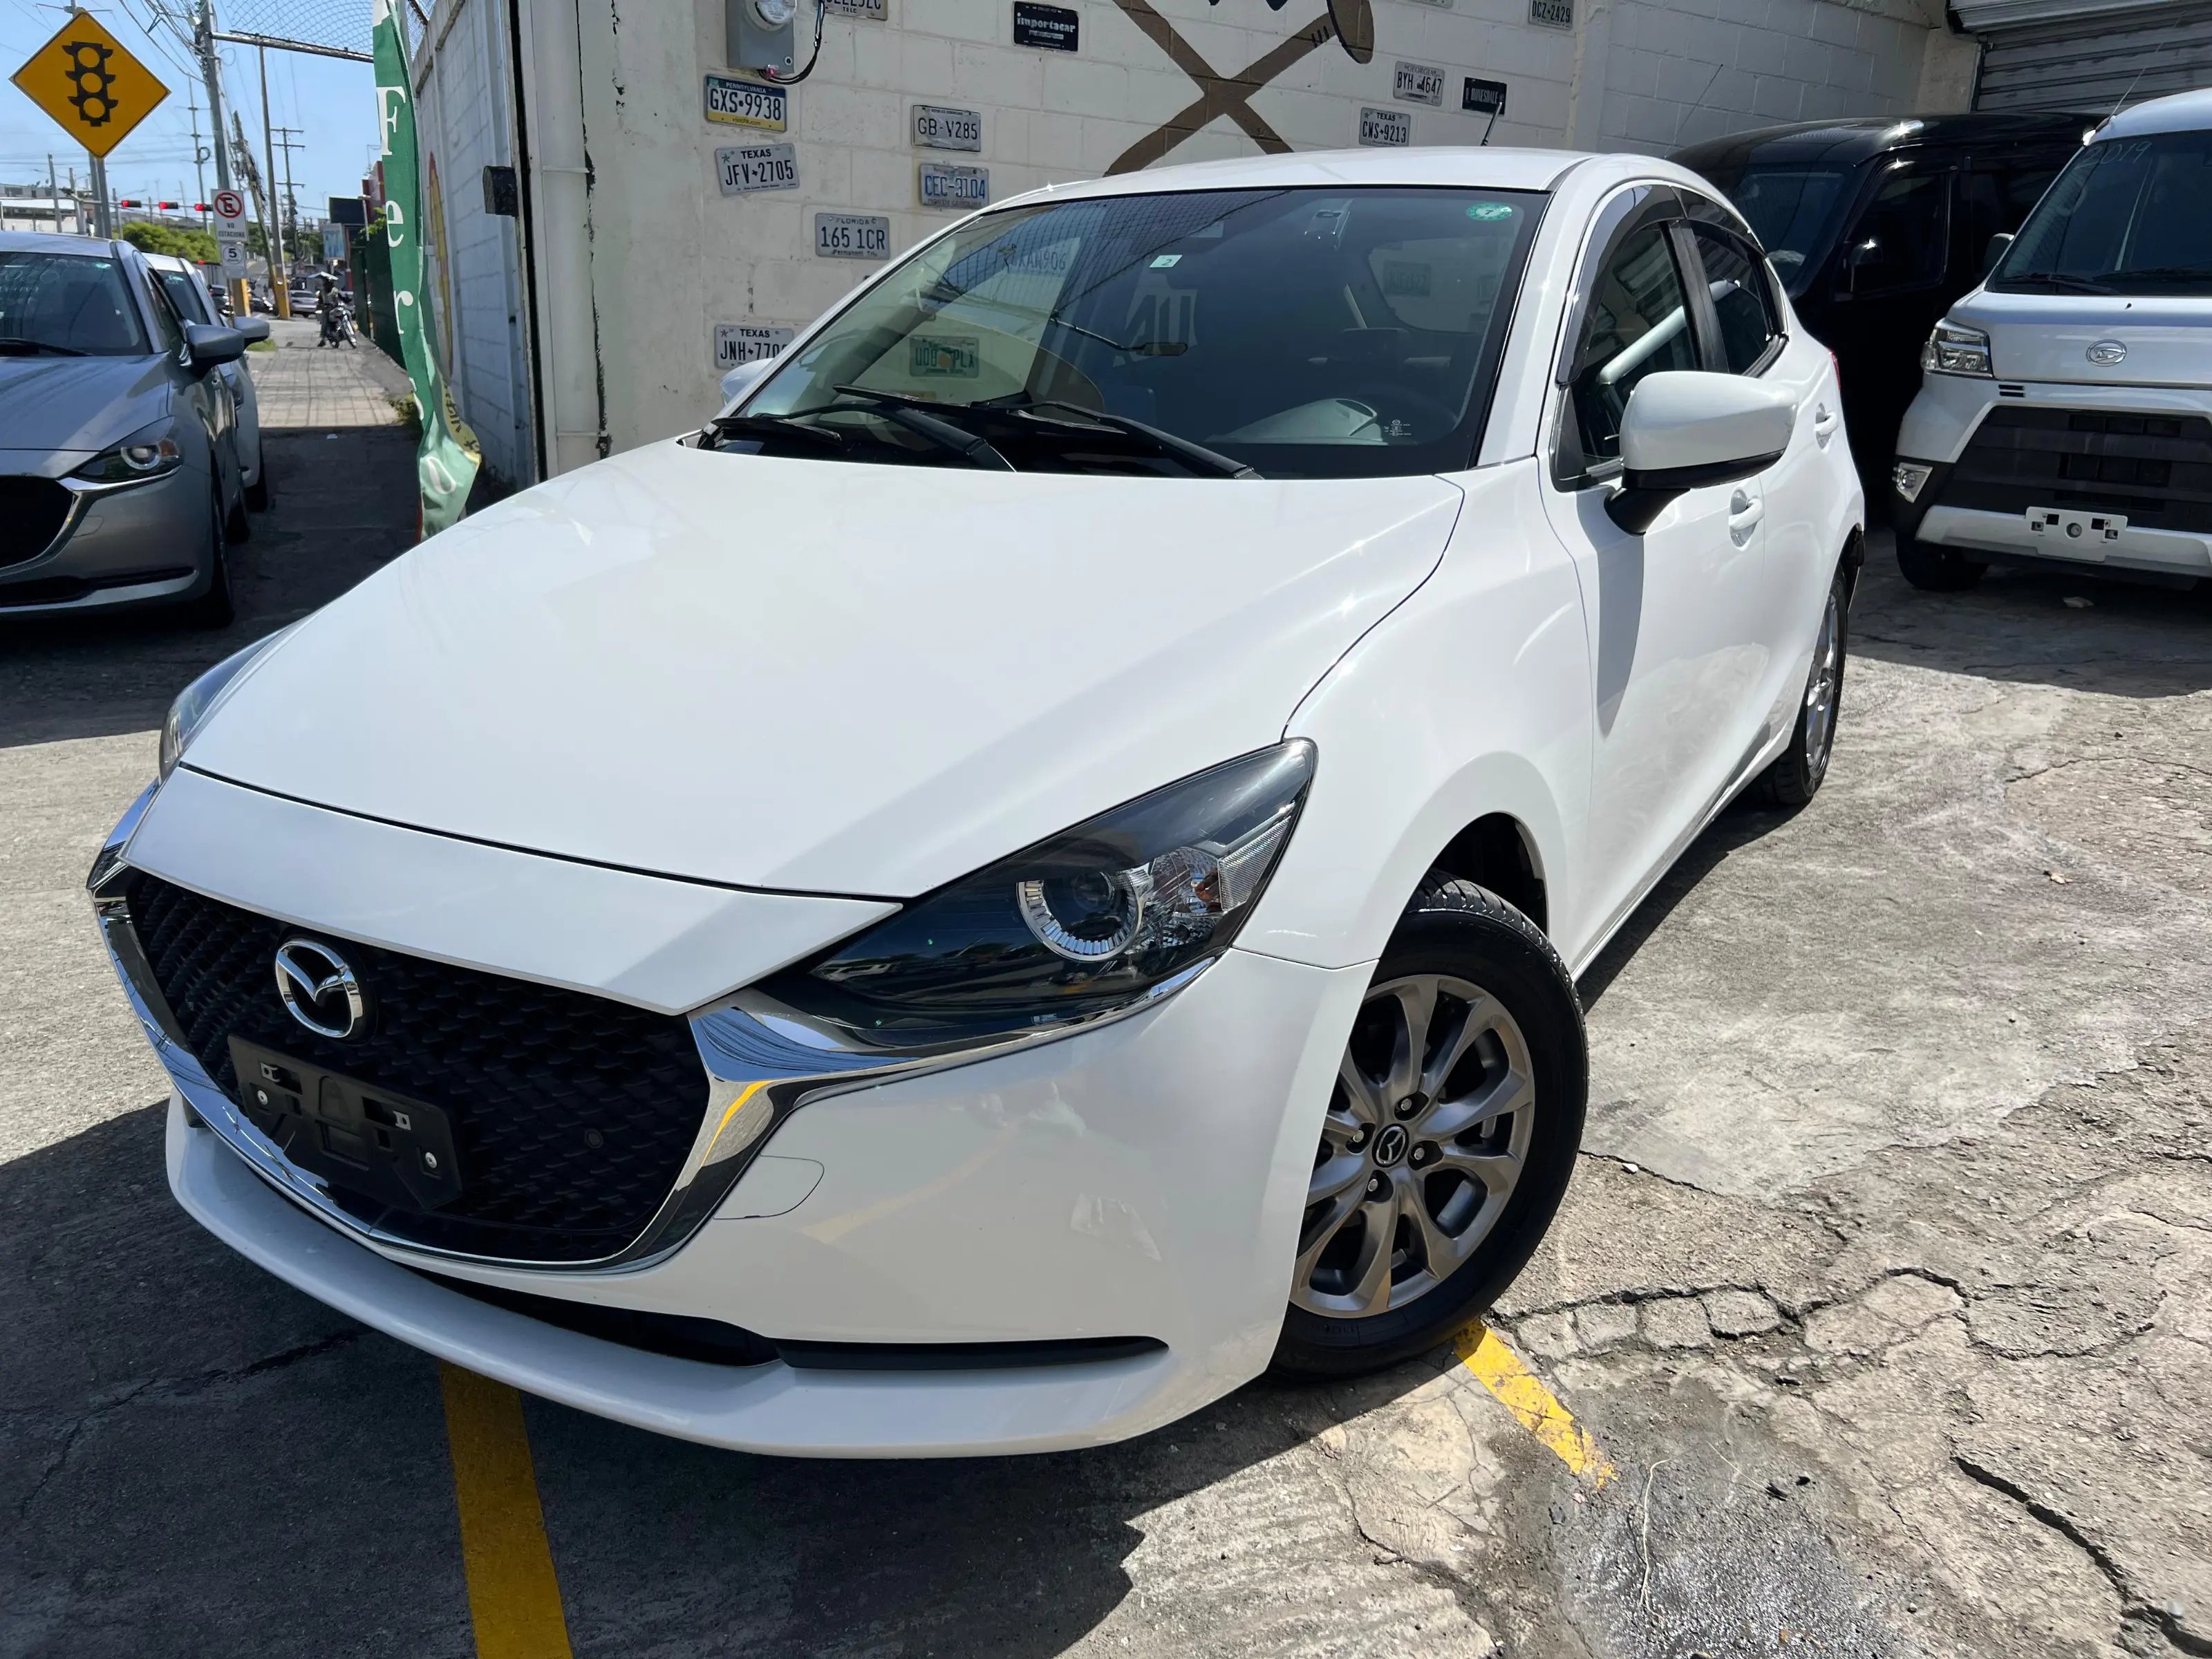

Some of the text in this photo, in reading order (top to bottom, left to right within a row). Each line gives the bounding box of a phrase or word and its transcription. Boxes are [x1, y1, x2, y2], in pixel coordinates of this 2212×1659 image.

[1550, 5, 1571, 23] 2429
[726, 82, 766, 94] PENNSYLVANIA
[1397, 71, 1442, 95] BYH 4647
[710, 88, 781, 121] GXS 9938
[1377, 112, 1396, 122] TEXAS
[1384, 124, 1407, 143] 9213
[741, 149, 771, 159] TEXAS
[2074, 141, 2153, 170] 2019
[726, 160, 794, 186] JFV 2705
[925, 175, 985, 199] CEC-3104
[821, 226, 885, 250] 165 1CR
[228, 247, 237, 258] 5
[740, 328, 770, 338] TEXAS
[720, 341, 788, 360] JNH 770
